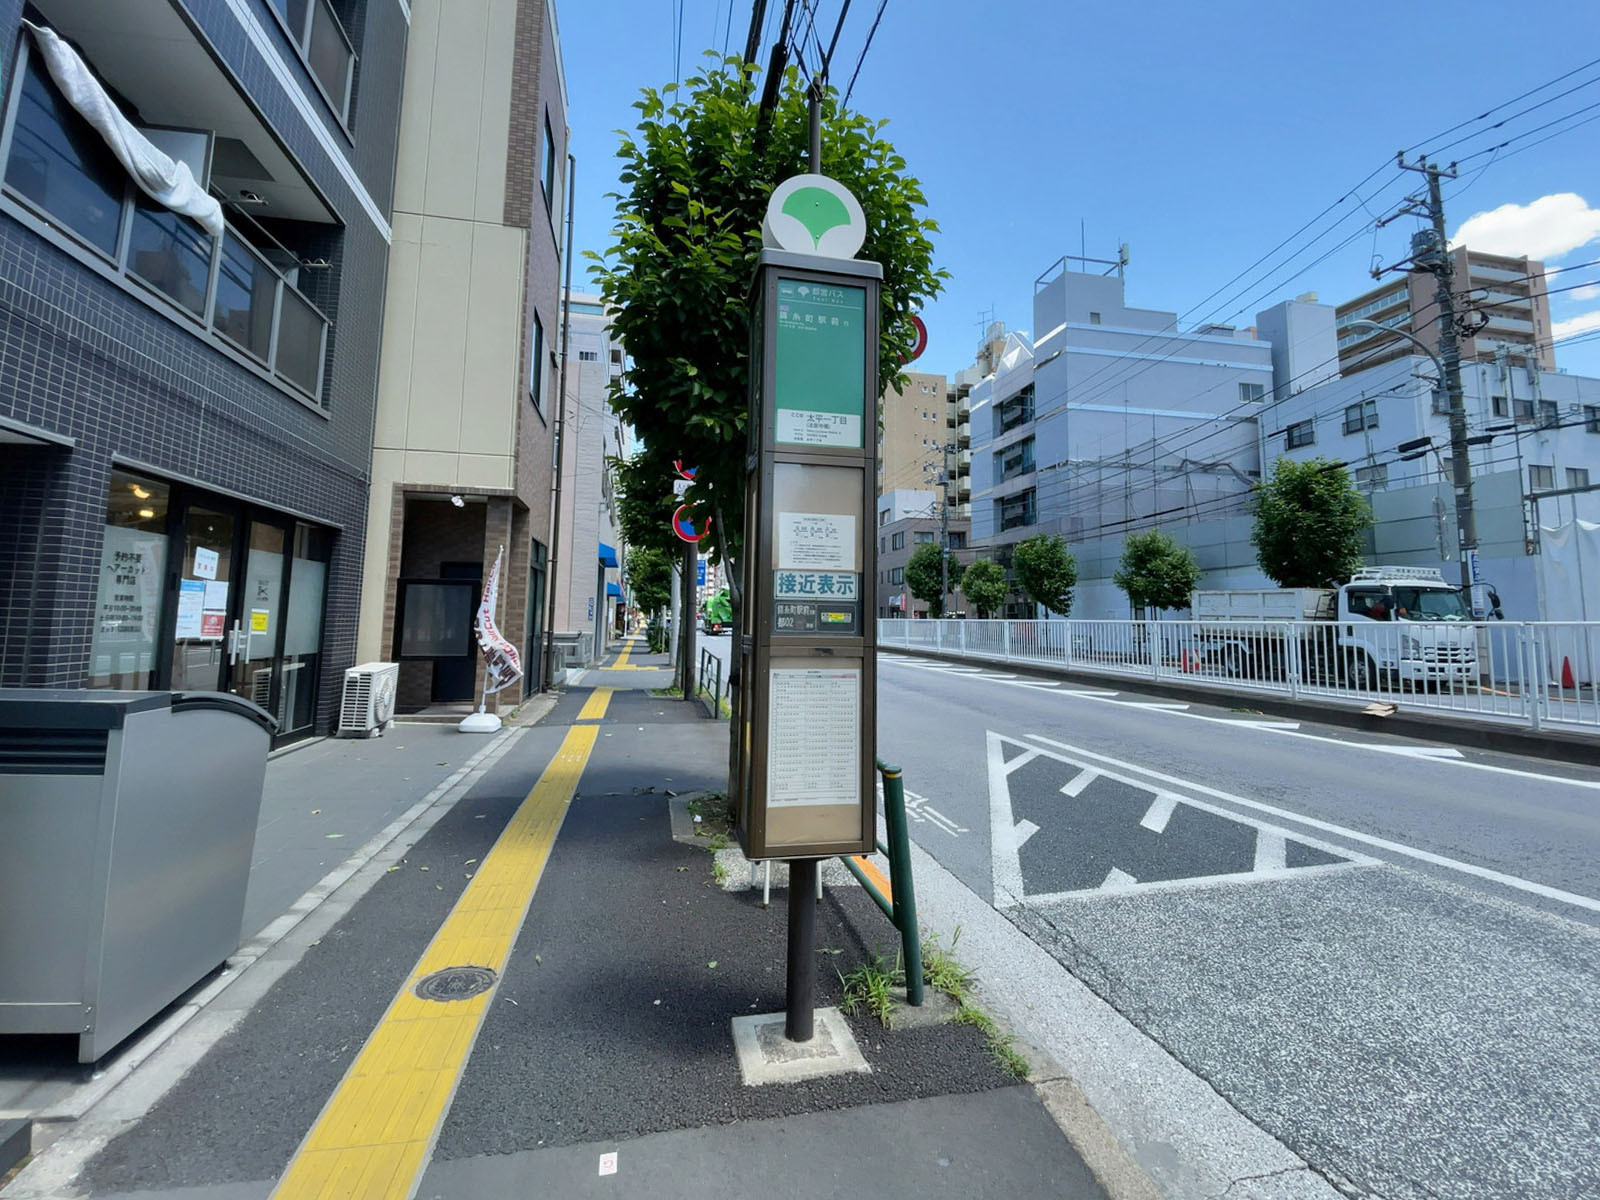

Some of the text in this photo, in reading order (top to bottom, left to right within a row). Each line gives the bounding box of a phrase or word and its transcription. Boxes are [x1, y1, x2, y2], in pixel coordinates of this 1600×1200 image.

[811, 287, 844, 298] 都営バス
[806, 413, 848, 425] 太平一丁目
[778, 572, 854, 595] 接近表示
